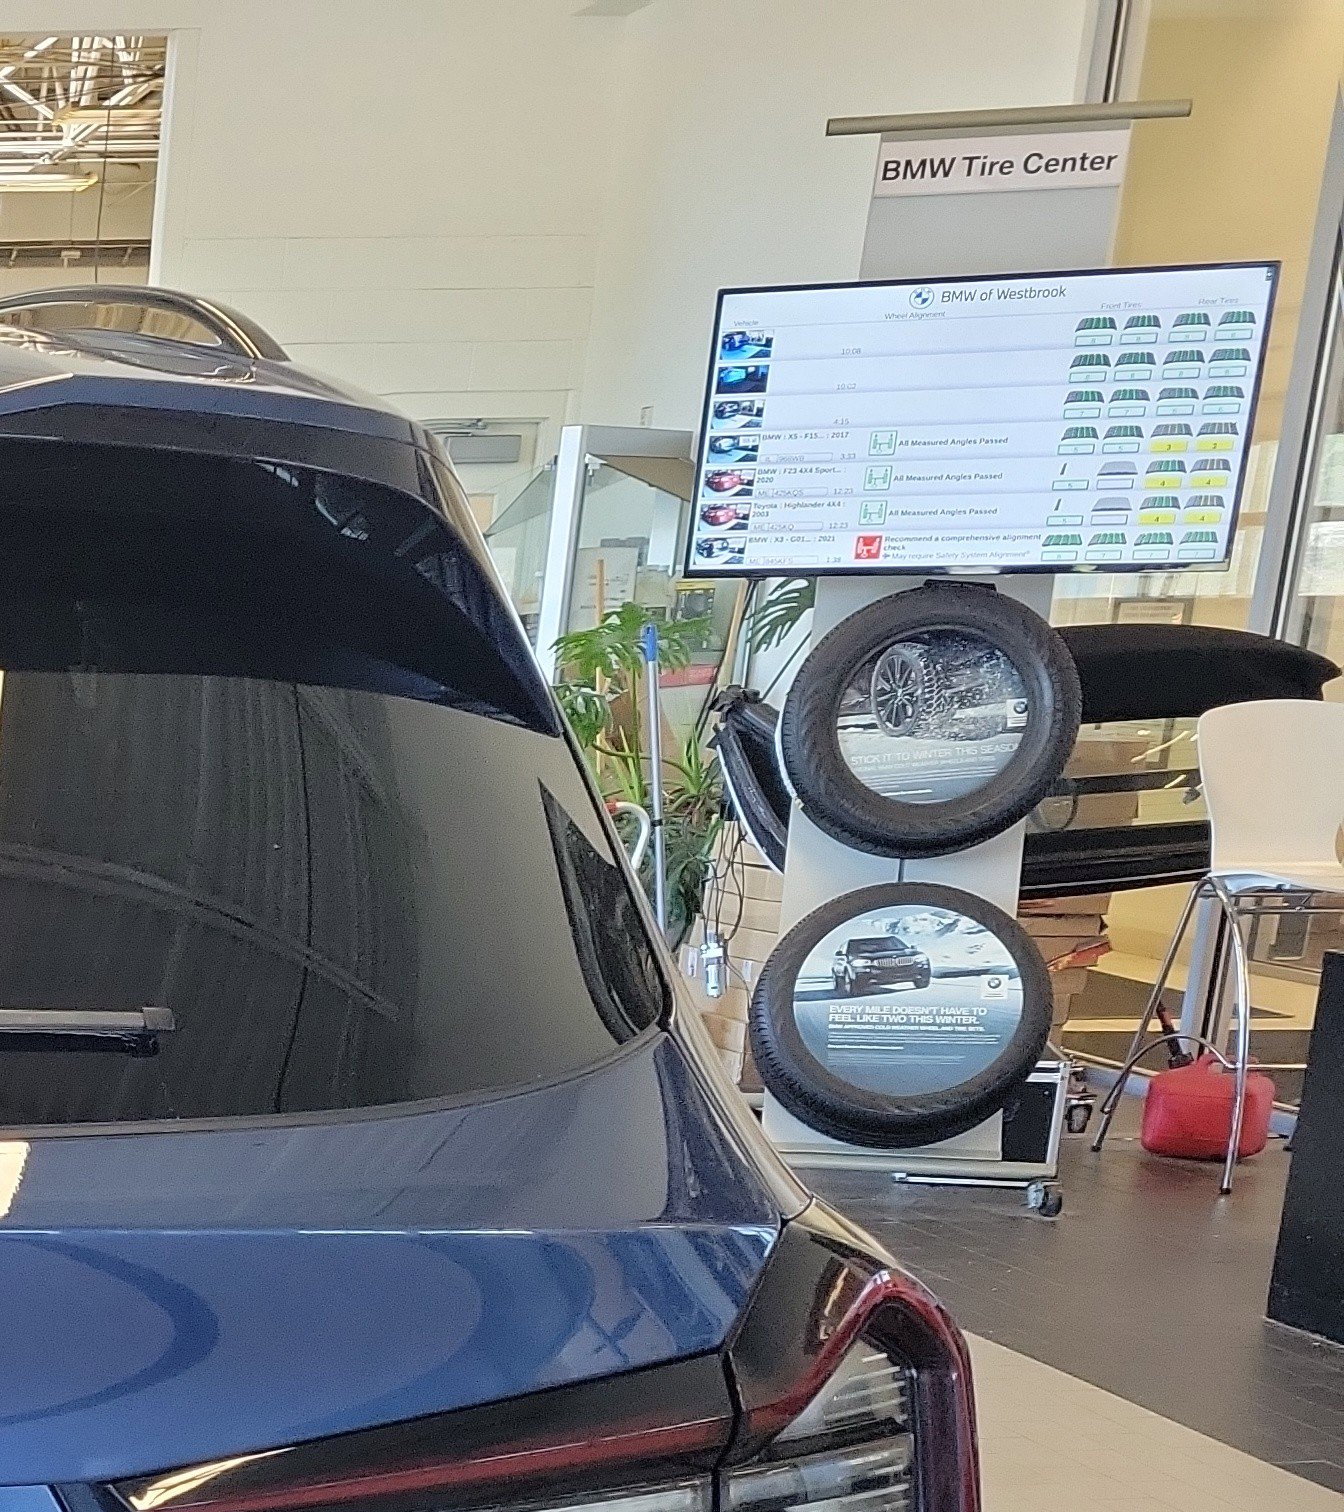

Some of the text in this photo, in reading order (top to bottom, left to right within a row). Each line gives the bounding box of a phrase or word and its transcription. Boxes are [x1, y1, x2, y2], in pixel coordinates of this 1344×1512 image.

[882, 152, 1118, 181] BMW Tire Center
[941, 285, 1066, 302] BMW of Westbrook
[909, 311, 945, 320] Alignment
[898, 439, 909, 447] All
[911, 438, 948, 446] Measured
[950, 437, 977, 446] Angles
[893, 474, 904, 482] All
[906, 473, 943, 481] Measured
[945, 473, 971, 481] Angles
[940, 508, 967, 517] Angles
[941, 535, 1000, 543] comprehensive
[1002, 534, 1041, 542] alignment
[908, 552, 933, 560] require
[936, 552, 958, 560] Safety
[960, 552, 988, 560] System
[851, 754, 880, 765] STICK
[883, 753, 891, 762] IT
[895, 752, 910, 761] TO
[912, 750, 952, 759] WINTER
[955, 747, 977, 756] THIS
[829, 1005, 987, 1016] EVERY MILE DOESN'T HAVE TO
[829, 1014, 854, 1022] FEEL
[882, 1015, 906, 1023] TWO
[909, 1015, 933, 1023] THIS
[935, 1016, 980, 1024] WINTER.
